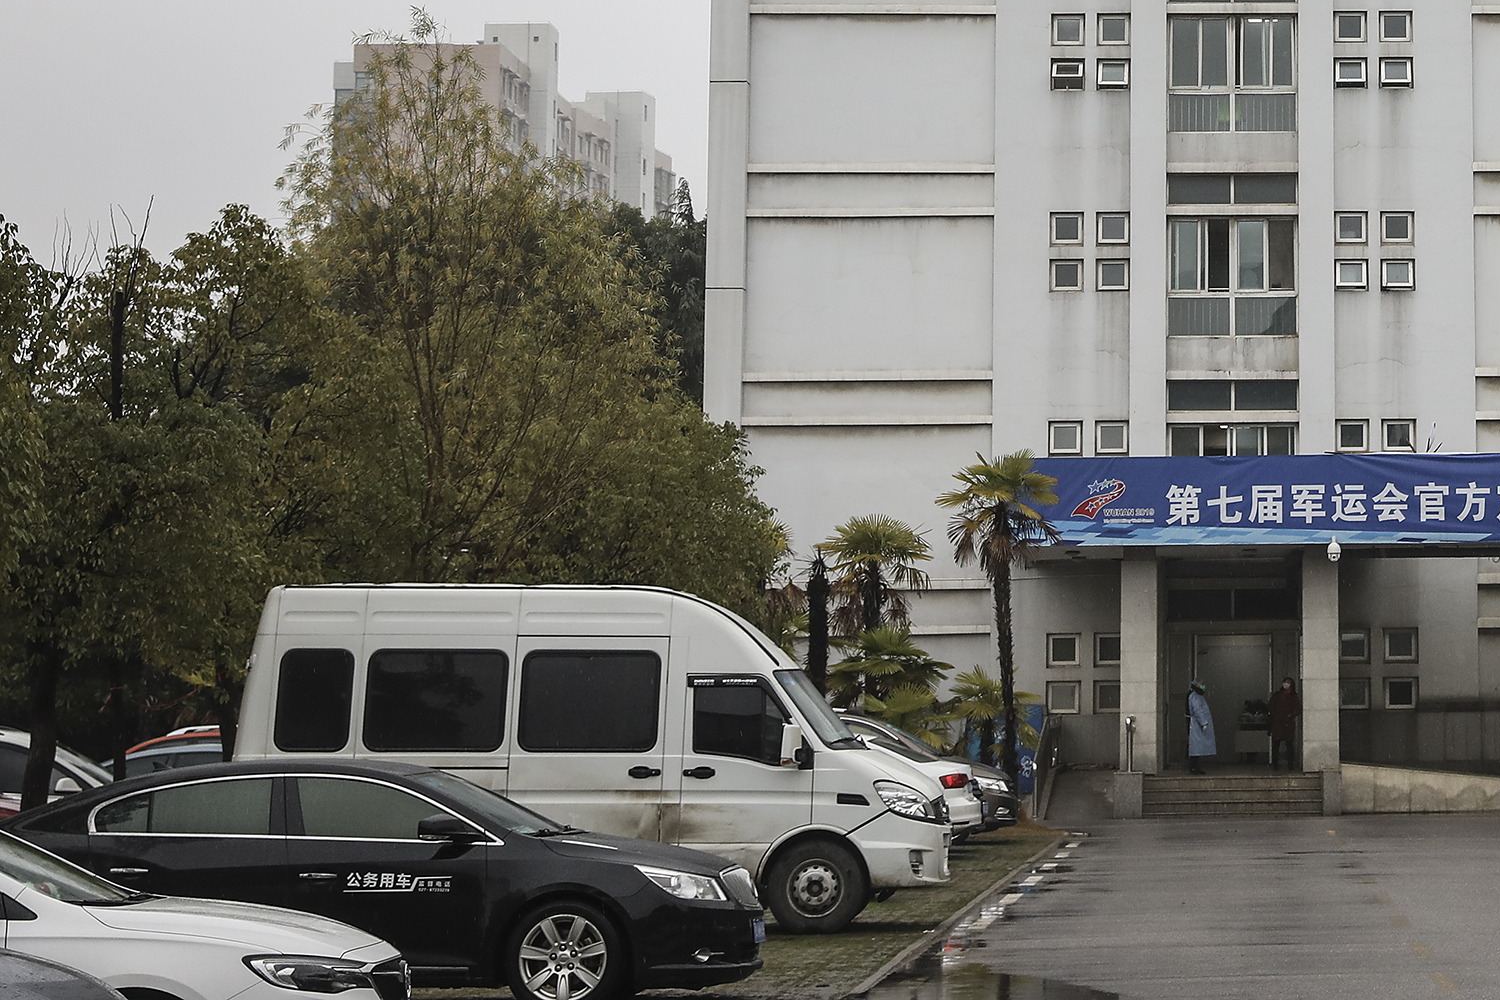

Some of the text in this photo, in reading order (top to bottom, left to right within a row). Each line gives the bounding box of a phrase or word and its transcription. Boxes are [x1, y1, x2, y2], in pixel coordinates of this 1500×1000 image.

[1103, 508, 1134, 517] WUHAN
[346, 872, 412, 888] 公务用车
